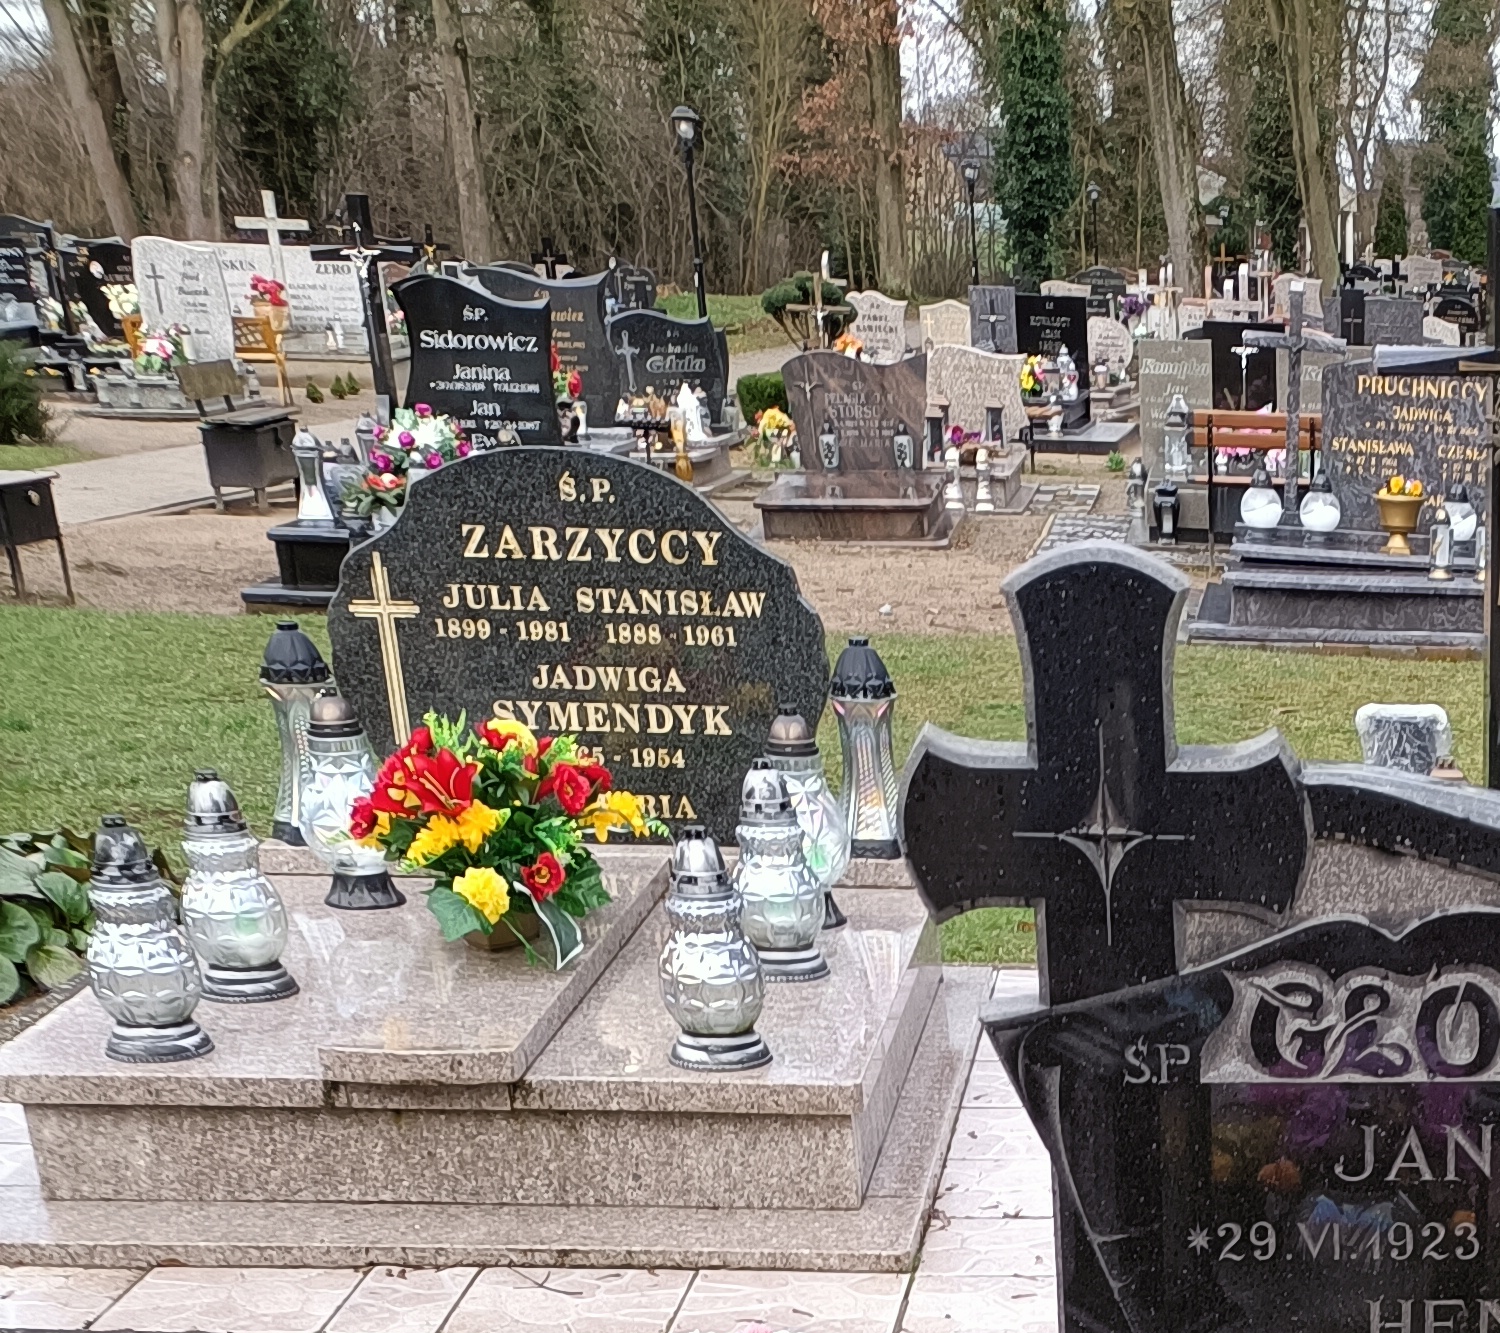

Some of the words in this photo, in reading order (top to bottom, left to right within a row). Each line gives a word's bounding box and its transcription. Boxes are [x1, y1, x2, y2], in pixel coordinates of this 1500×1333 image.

[315, 263, 351, 275] ZERO
[420, 329, 539, 353] Sidorowicz
[453, 363, 511, 382] Janina
[1357, 374, 1488, 403] PRUCHNICCY
[470, 400, 501, 417] Jan
[1392, 405, 1453, 423] JADWIGA
[1331, 436, 1414, 456] STANISŁAWA
[461, 522, 722, 566] ZARZYCCY
[442, 584, 550, 612] JULIA
[576, 586, 766, 619] STANISŁAW
[434, 618, 491, 640] 1899
[516, 621, 571, 643] 1981
[605, 623, 661, 645] 1888
[684, 625, 738, 648] 1961
[532, 665, 686, 693] JADWIGA
[492, 700, 733, 736] SYMENDYK
[629, 747, 687, 769] 1954
